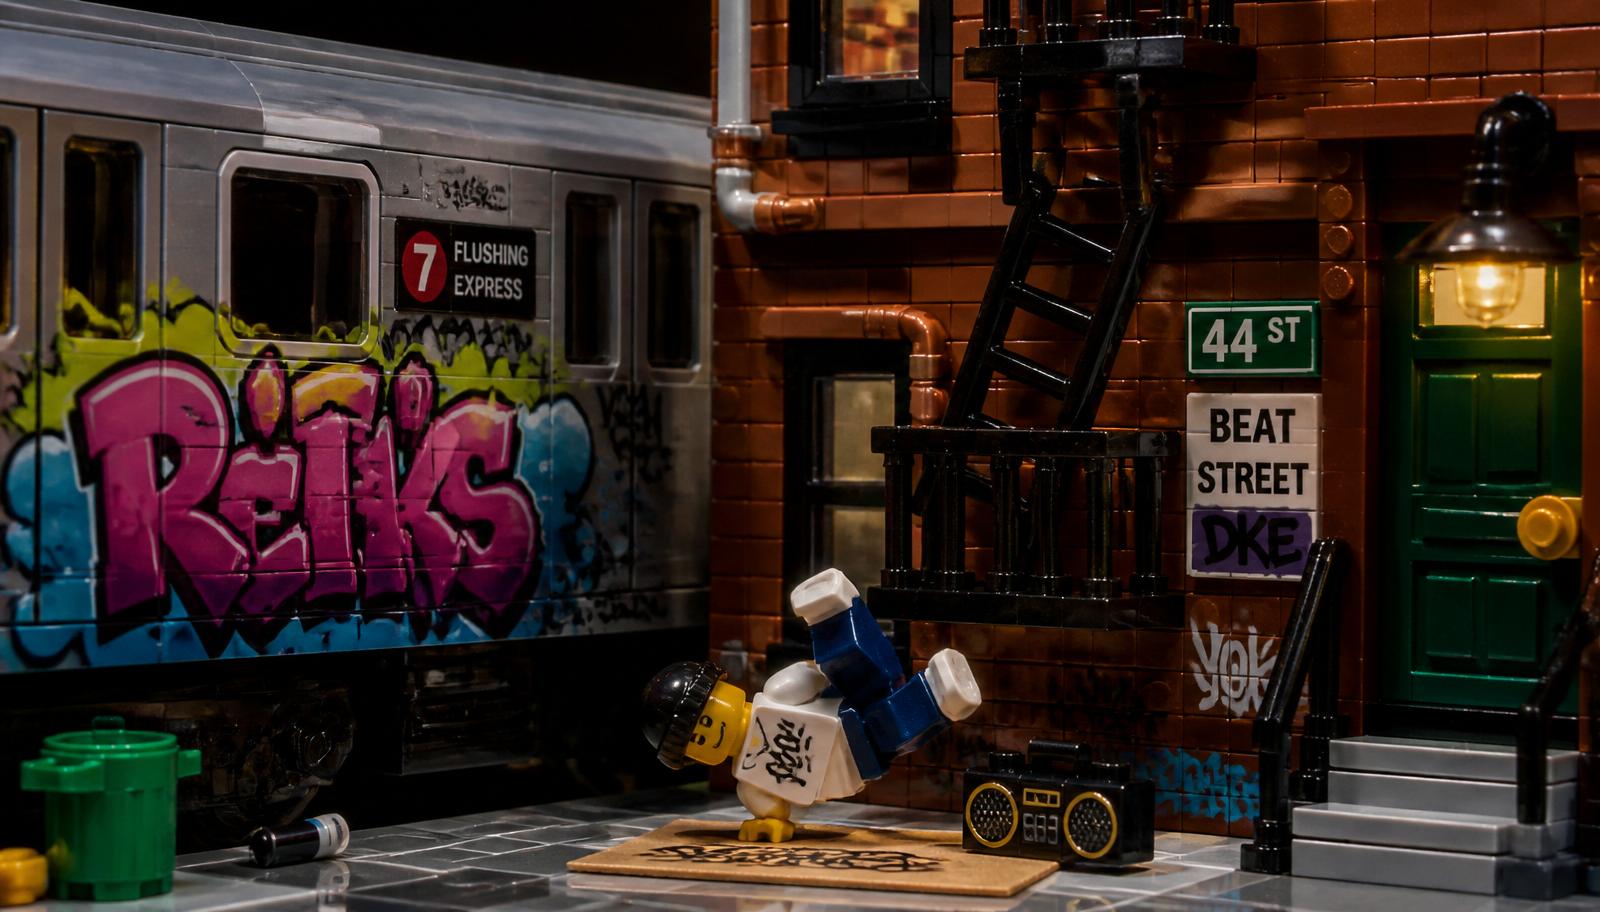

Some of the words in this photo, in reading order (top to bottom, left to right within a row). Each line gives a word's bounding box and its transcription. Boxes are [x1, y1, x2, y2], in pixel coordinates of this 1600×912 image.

[413, 242, 437, 292] 7
[454, 240, 529, 267] FLUSHING
[454, 274, 523, 300] EXPRESS
[1202, 318, 1257, 363] 44
[1267, 316, 1301, 344] ST
[1210, 408, 1296, 443] BEAT
[1197, 460, 1309, 495] STREET
[1201, 510, 1303, 569] DKE
